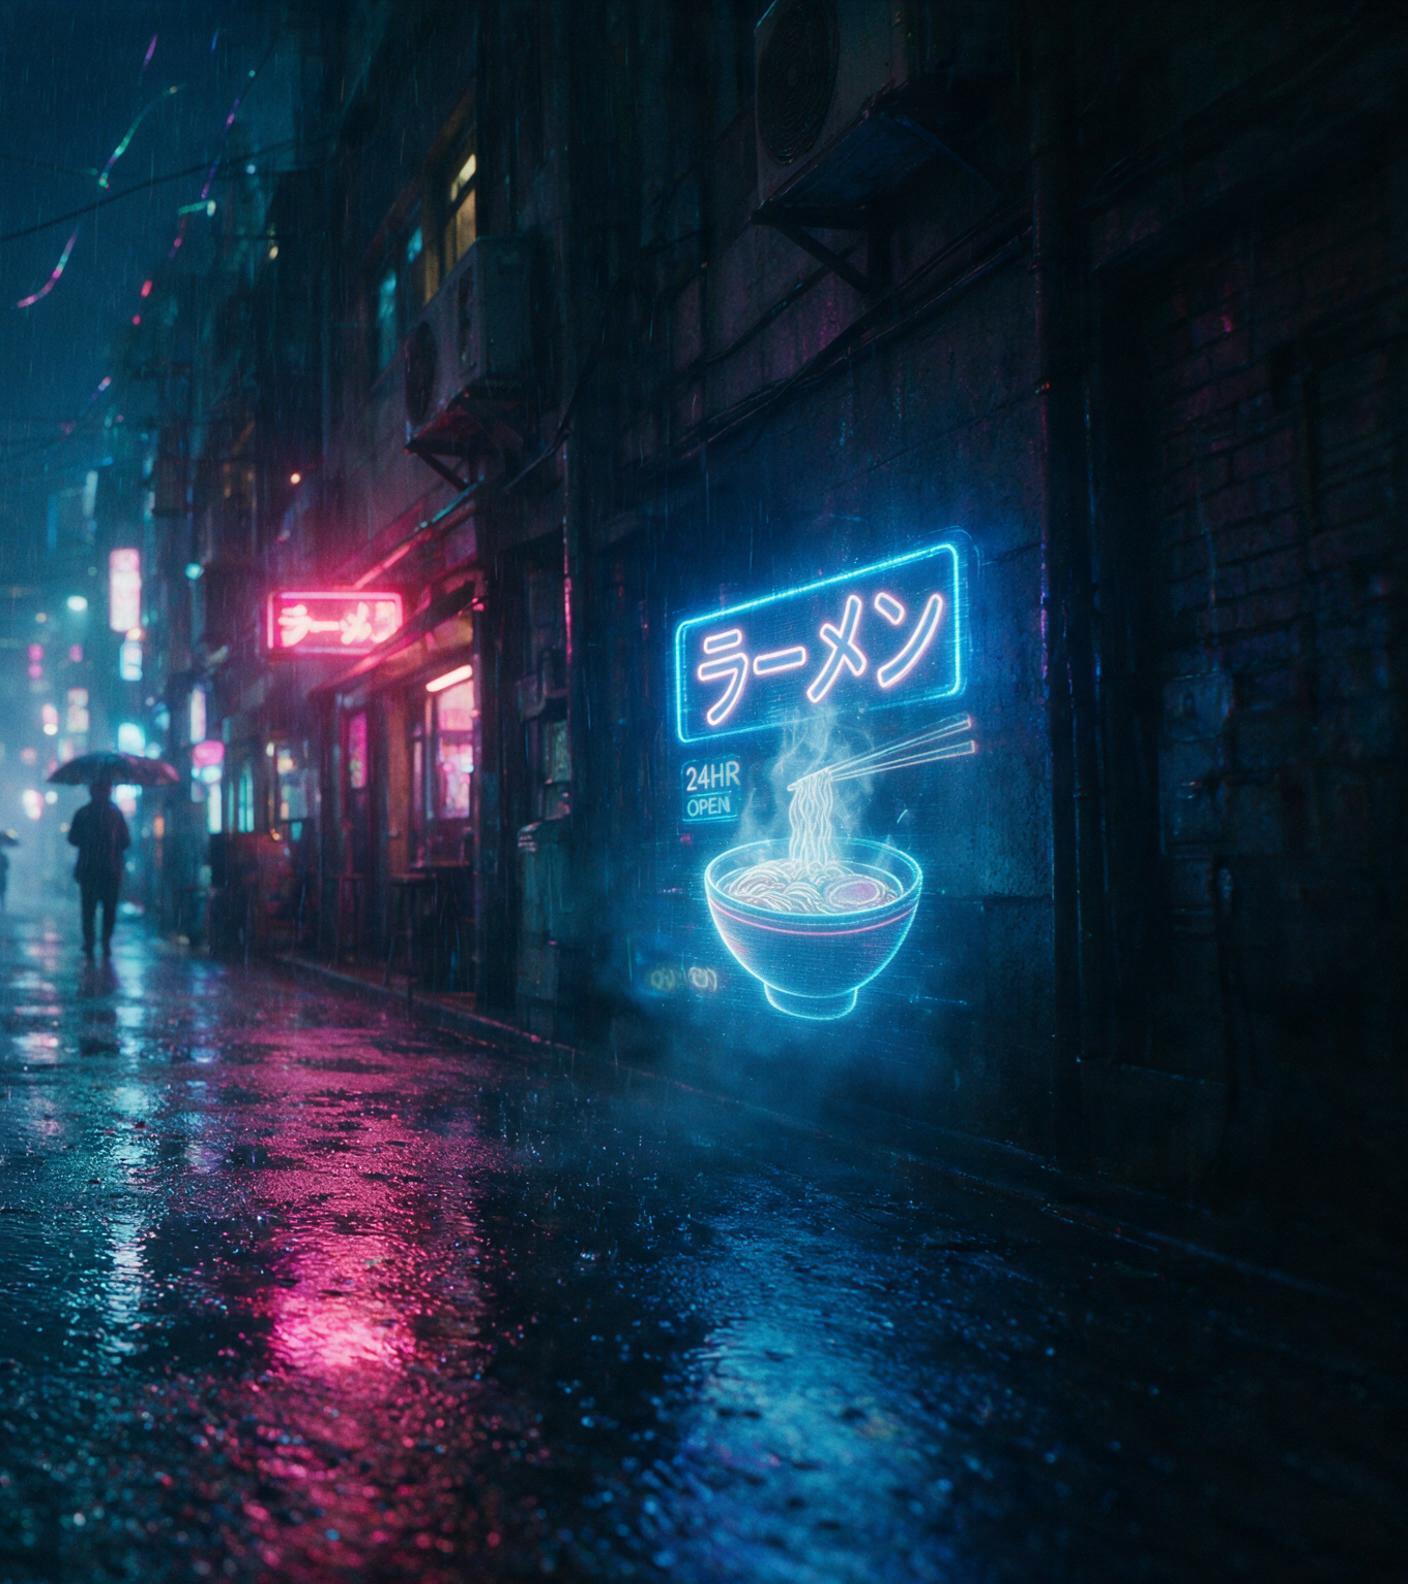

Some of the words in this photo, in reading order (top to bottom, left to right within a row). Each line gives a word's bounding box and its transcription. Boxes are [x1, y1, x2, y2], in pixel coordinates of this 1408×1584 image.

[696, 592, 944, 725] ラーメン
[685, 760, 741, 792] 24HR
[687, 796, 731, 817] OPEN
